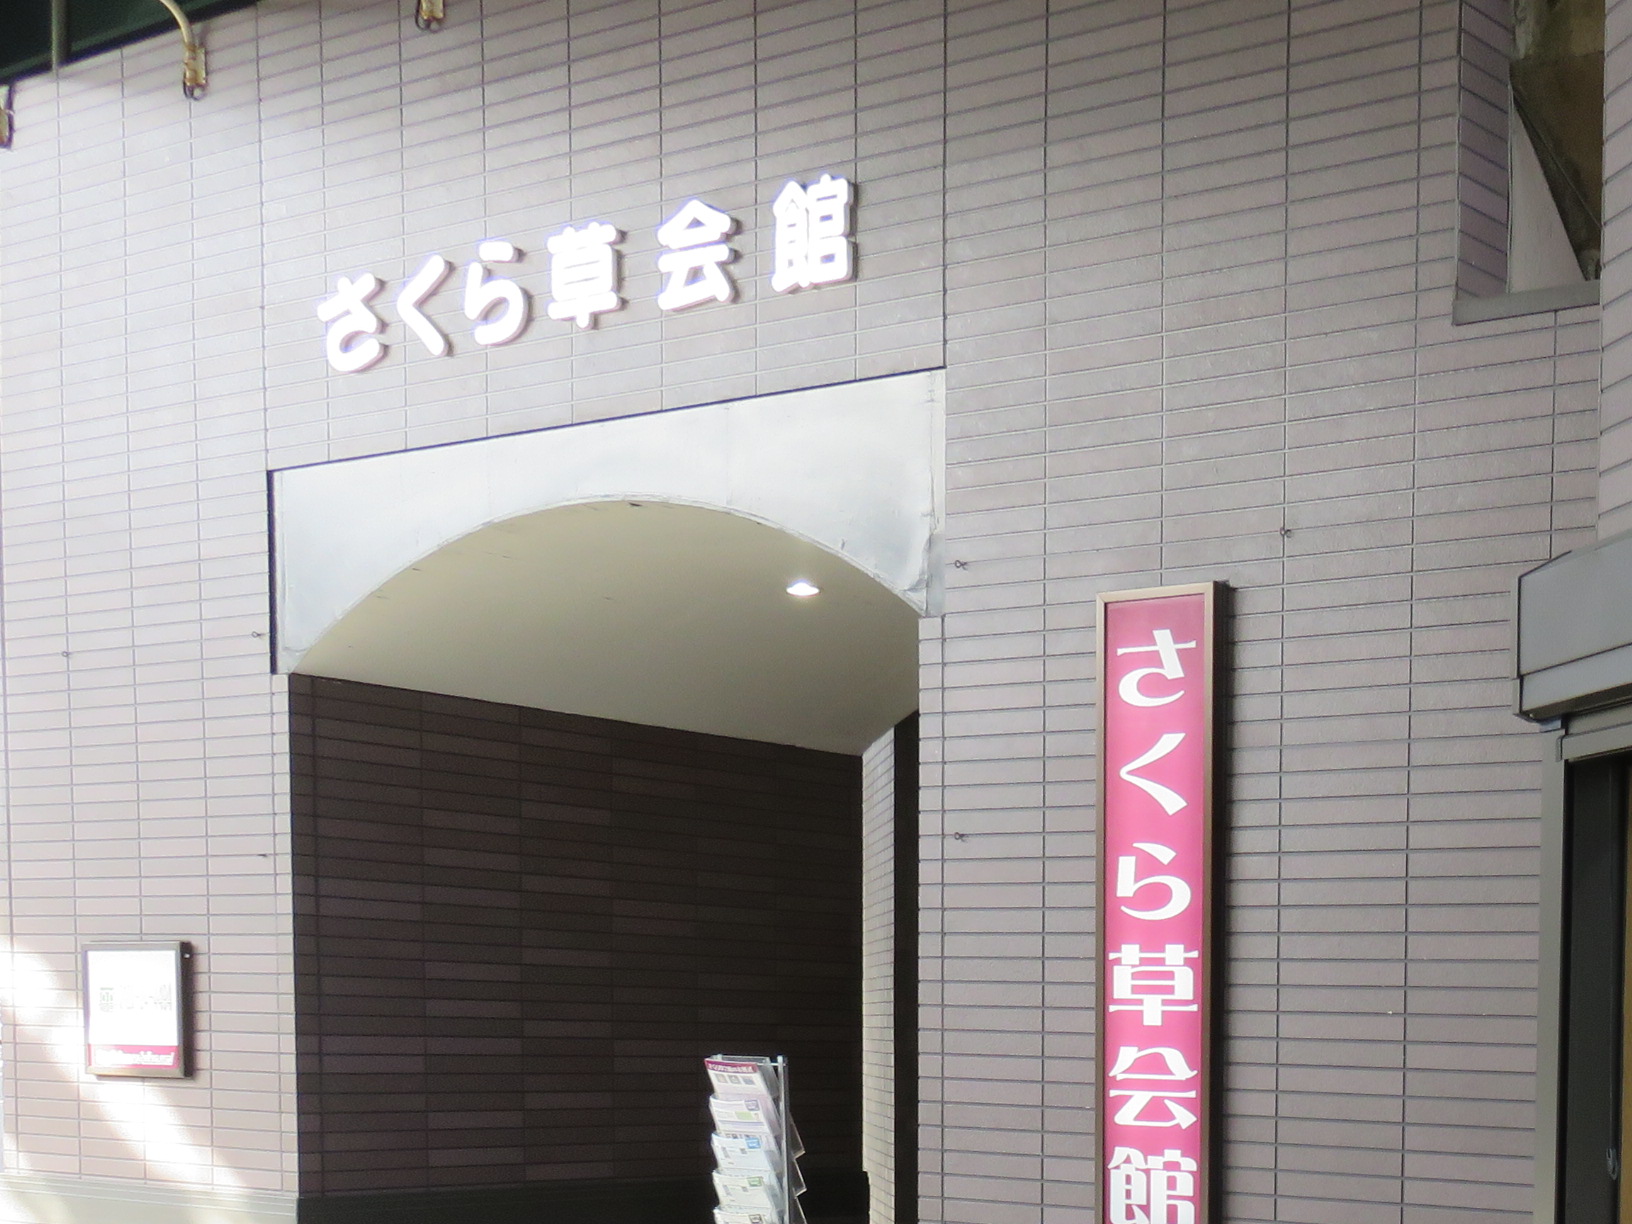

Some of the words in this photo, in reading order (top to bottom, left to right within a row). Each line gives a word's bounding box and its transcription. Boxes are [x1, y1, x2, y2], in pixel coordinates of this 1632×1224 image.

[317, 174, 857, 373] さくら草会館
